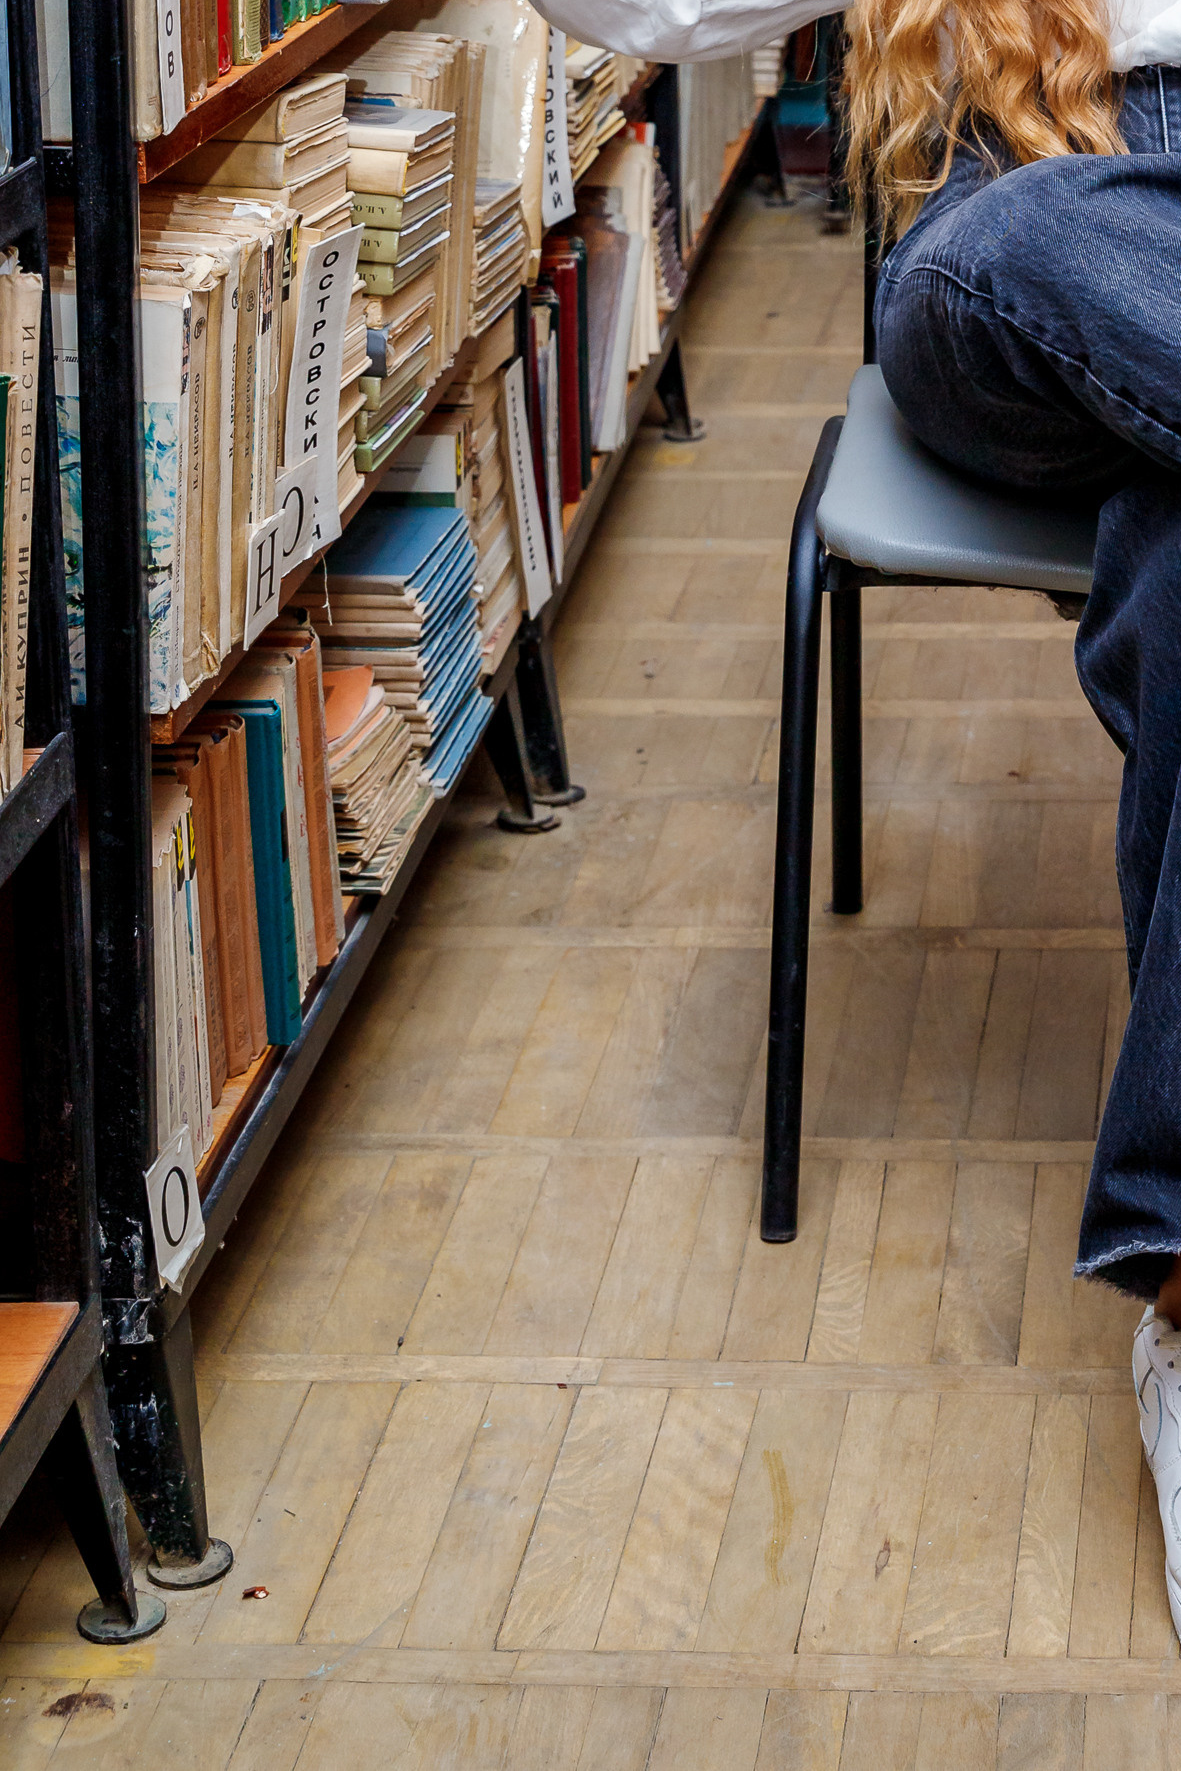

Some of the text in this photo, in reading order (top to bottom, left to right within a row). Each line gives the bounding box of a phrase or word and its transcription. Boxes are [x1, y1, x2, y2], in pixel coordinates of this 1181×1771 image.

[303, 250, 340, 454] ОСТРОВСКИ
[20, 324, 36, 494] ПОВЕСТИ
[191, 372, 200, 456] НЕКРАСОВ
[18, 545, 30, 669] КУПРИН
[252, 525, 280, 617] Н
[161, 1165, 190, 1248] О
